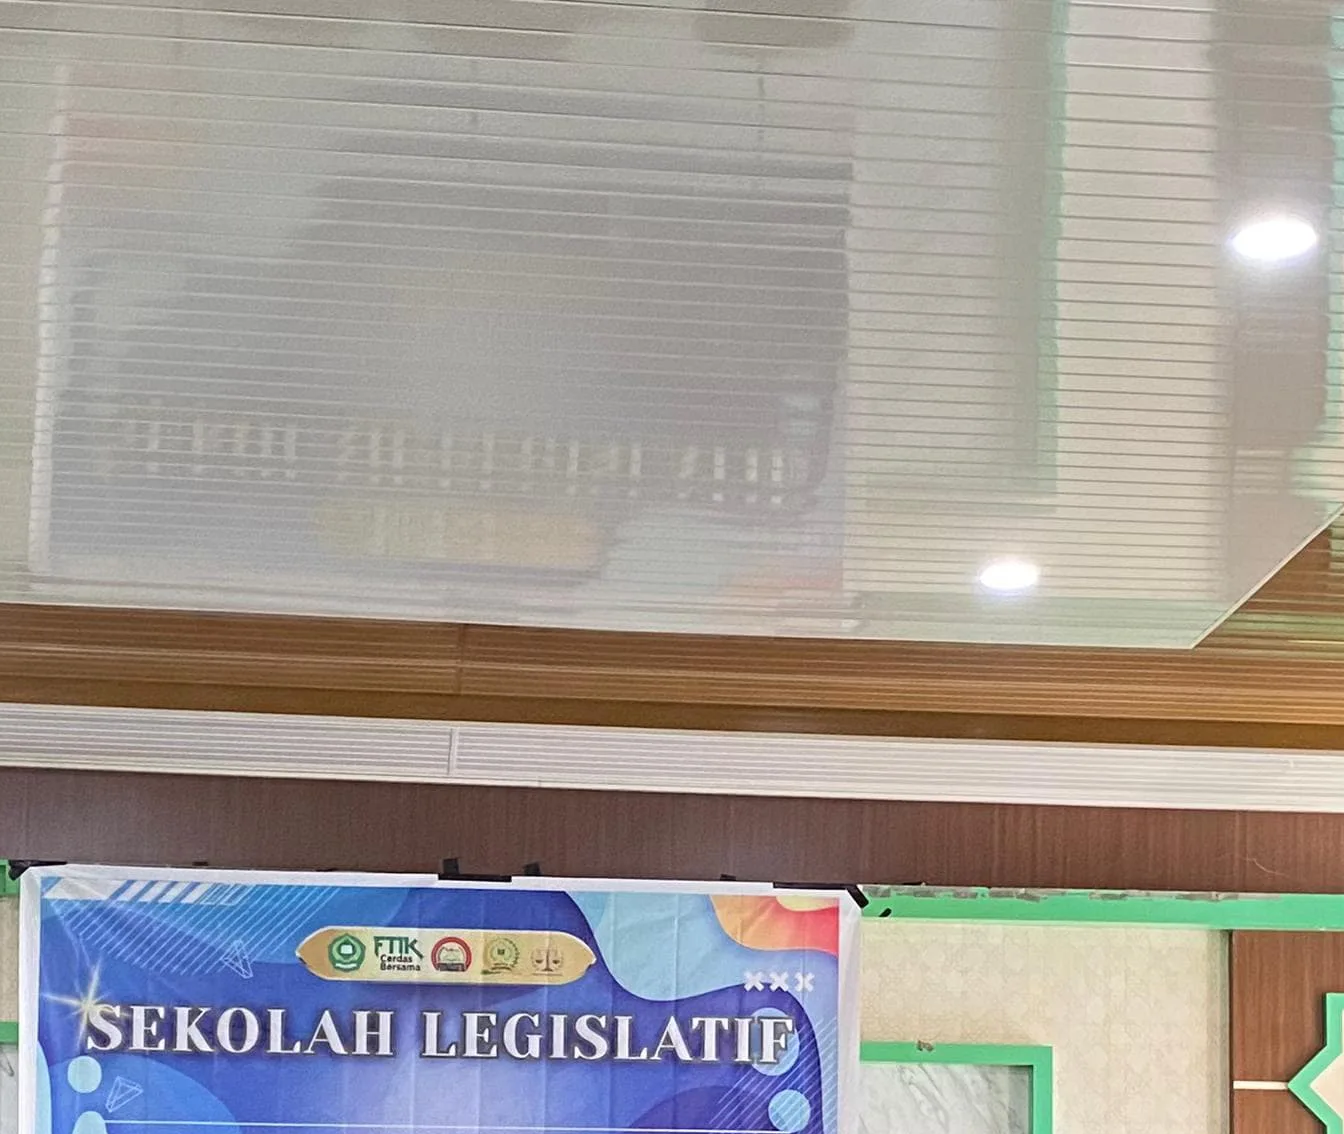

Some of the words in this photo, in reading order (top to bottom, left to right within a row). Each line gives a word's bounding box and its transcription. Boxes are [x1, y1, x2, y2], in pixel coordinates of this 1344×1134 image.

[373, 936, 424, 960] FTIK
[380, 953, 413, 963] Cerdas
[380, 962, 421, 971] Bersama
[87, 1004, 395, 1056] SEKOLAH
[422, 1010, 794, 1063] LEGISLATIF
